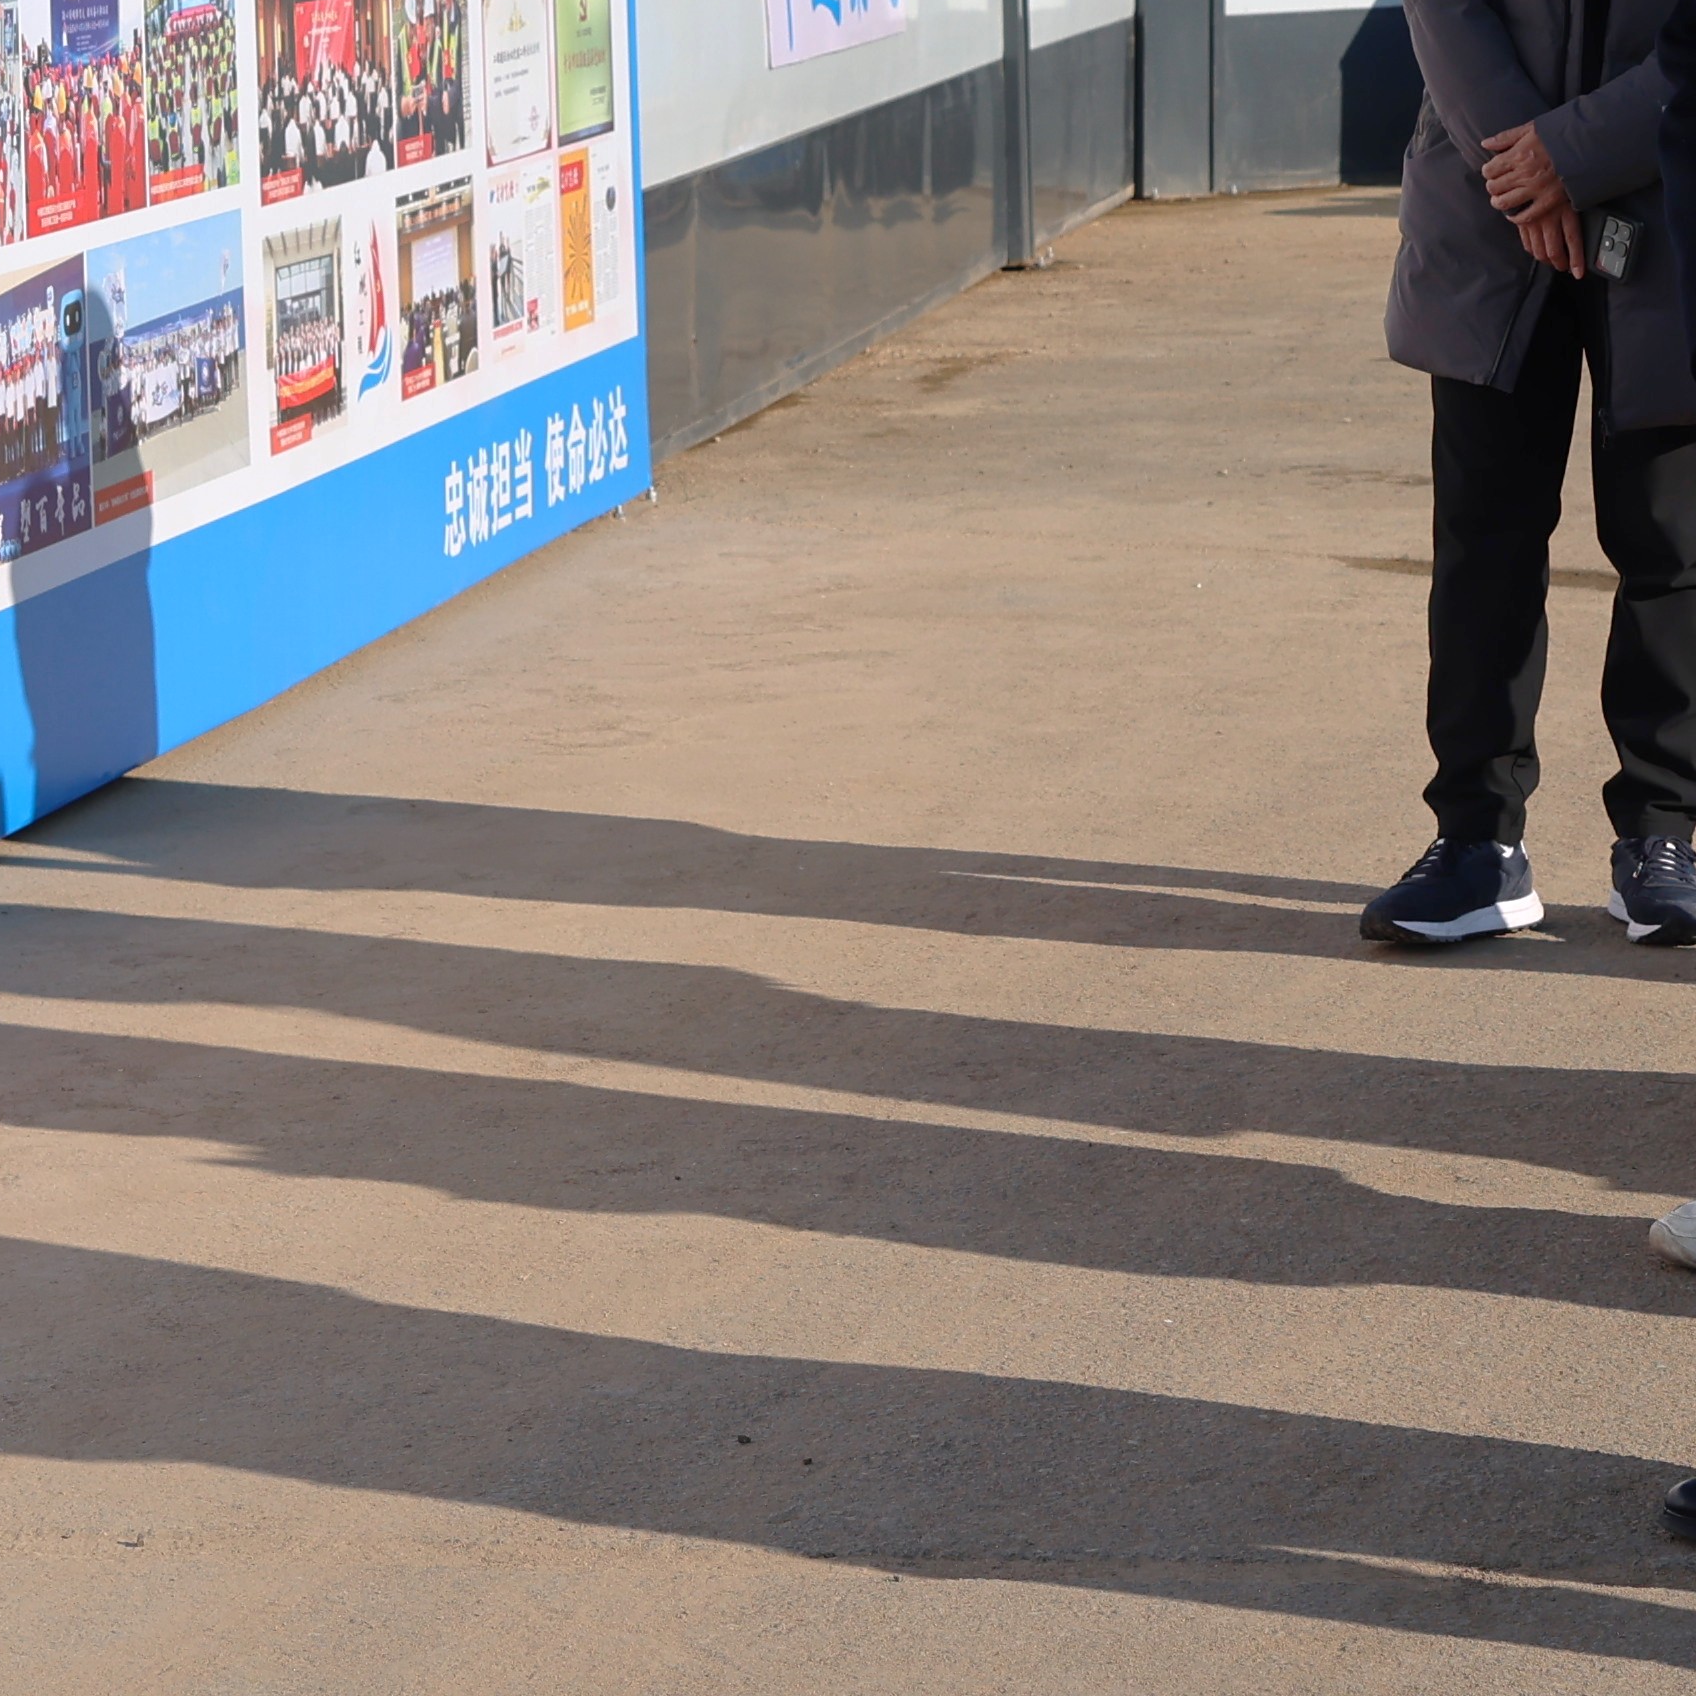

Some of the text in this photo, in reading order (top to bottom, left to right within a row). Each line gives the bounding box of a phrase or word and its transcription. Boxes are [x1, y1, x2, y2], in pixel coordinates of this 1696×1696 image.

[444, 385, 629, 557] 忠诚担当 使命必达
